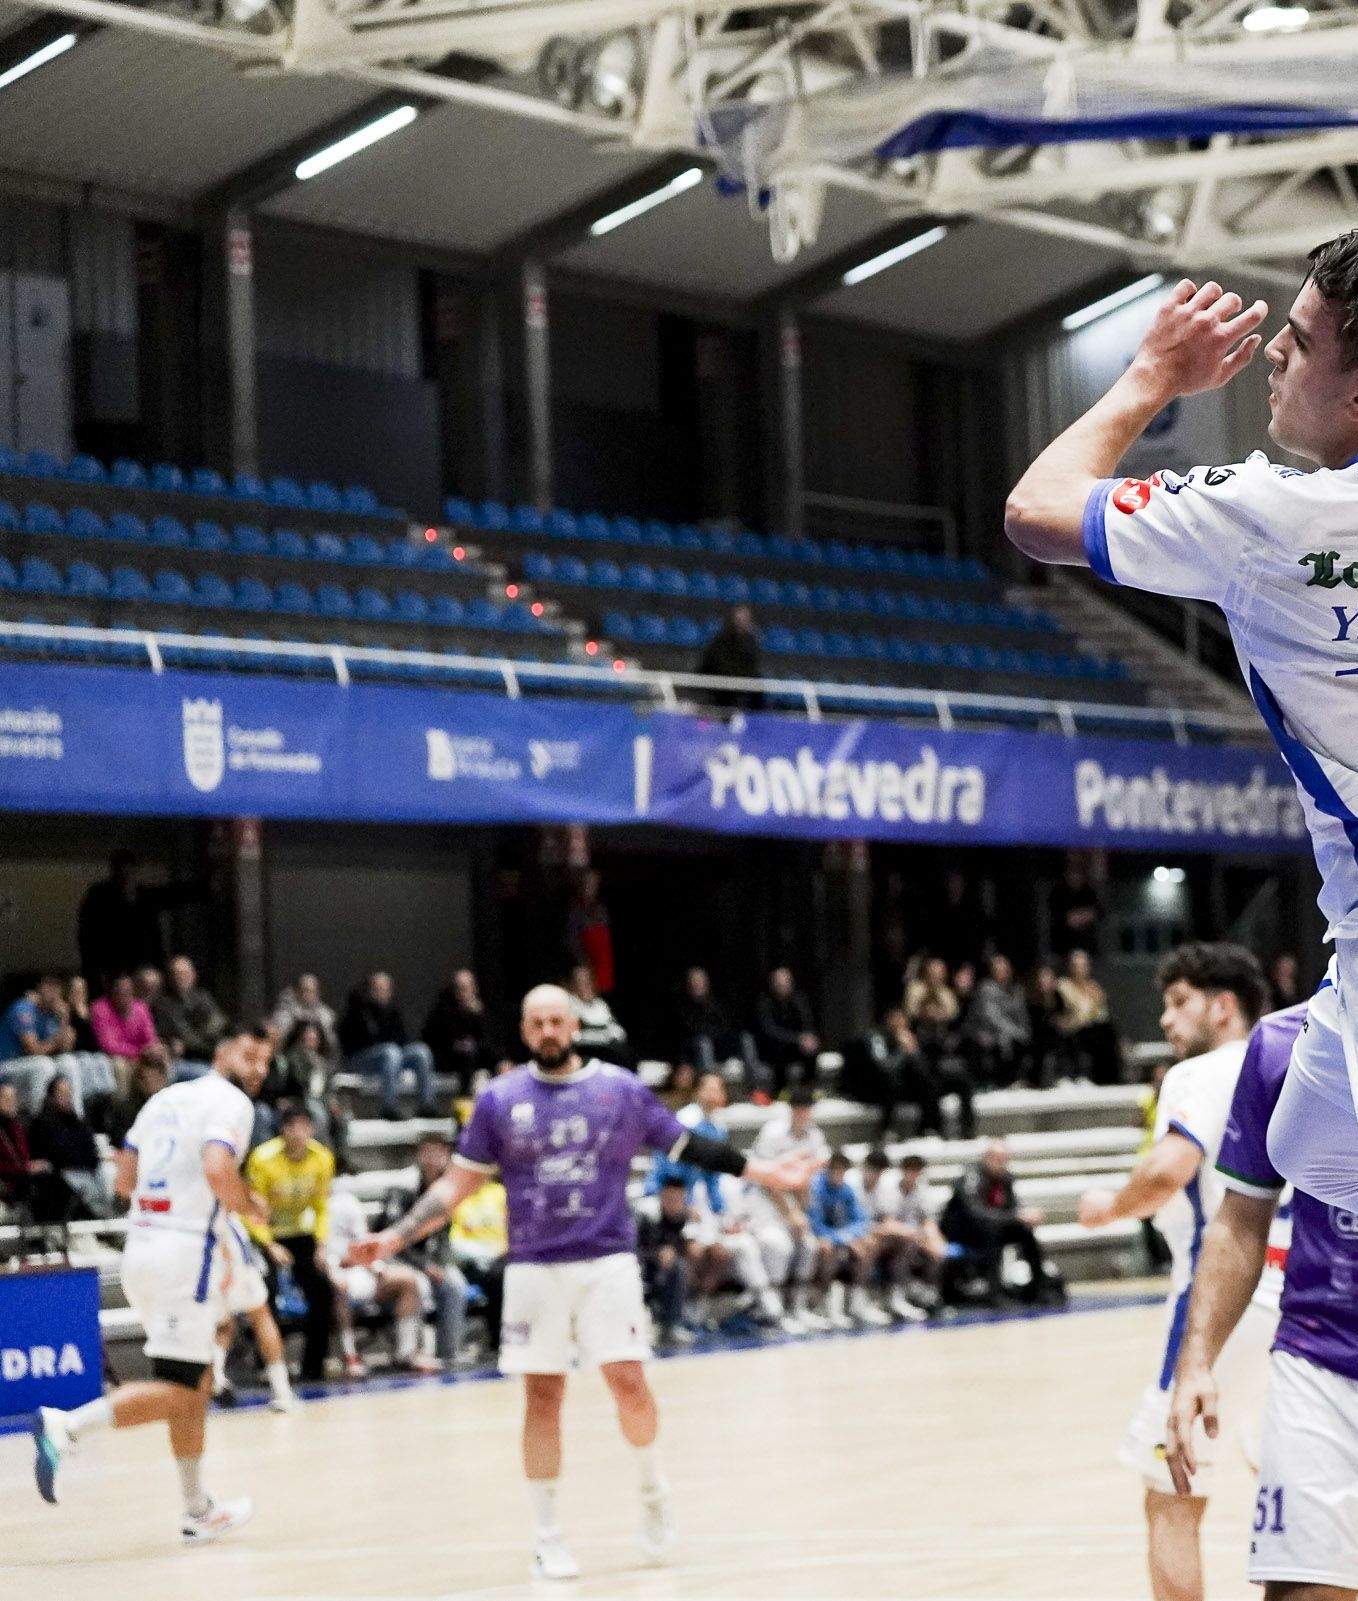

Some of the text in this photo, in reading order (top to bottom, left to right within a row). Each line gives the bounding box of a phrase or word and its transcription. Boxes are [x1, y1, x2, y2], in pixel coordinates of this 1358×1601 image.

[705, 742, 985, 826] Pontevedra
[1075, 758, 1305, 837] Pontevedra
[1, 1343, 86, 1381] DRA
